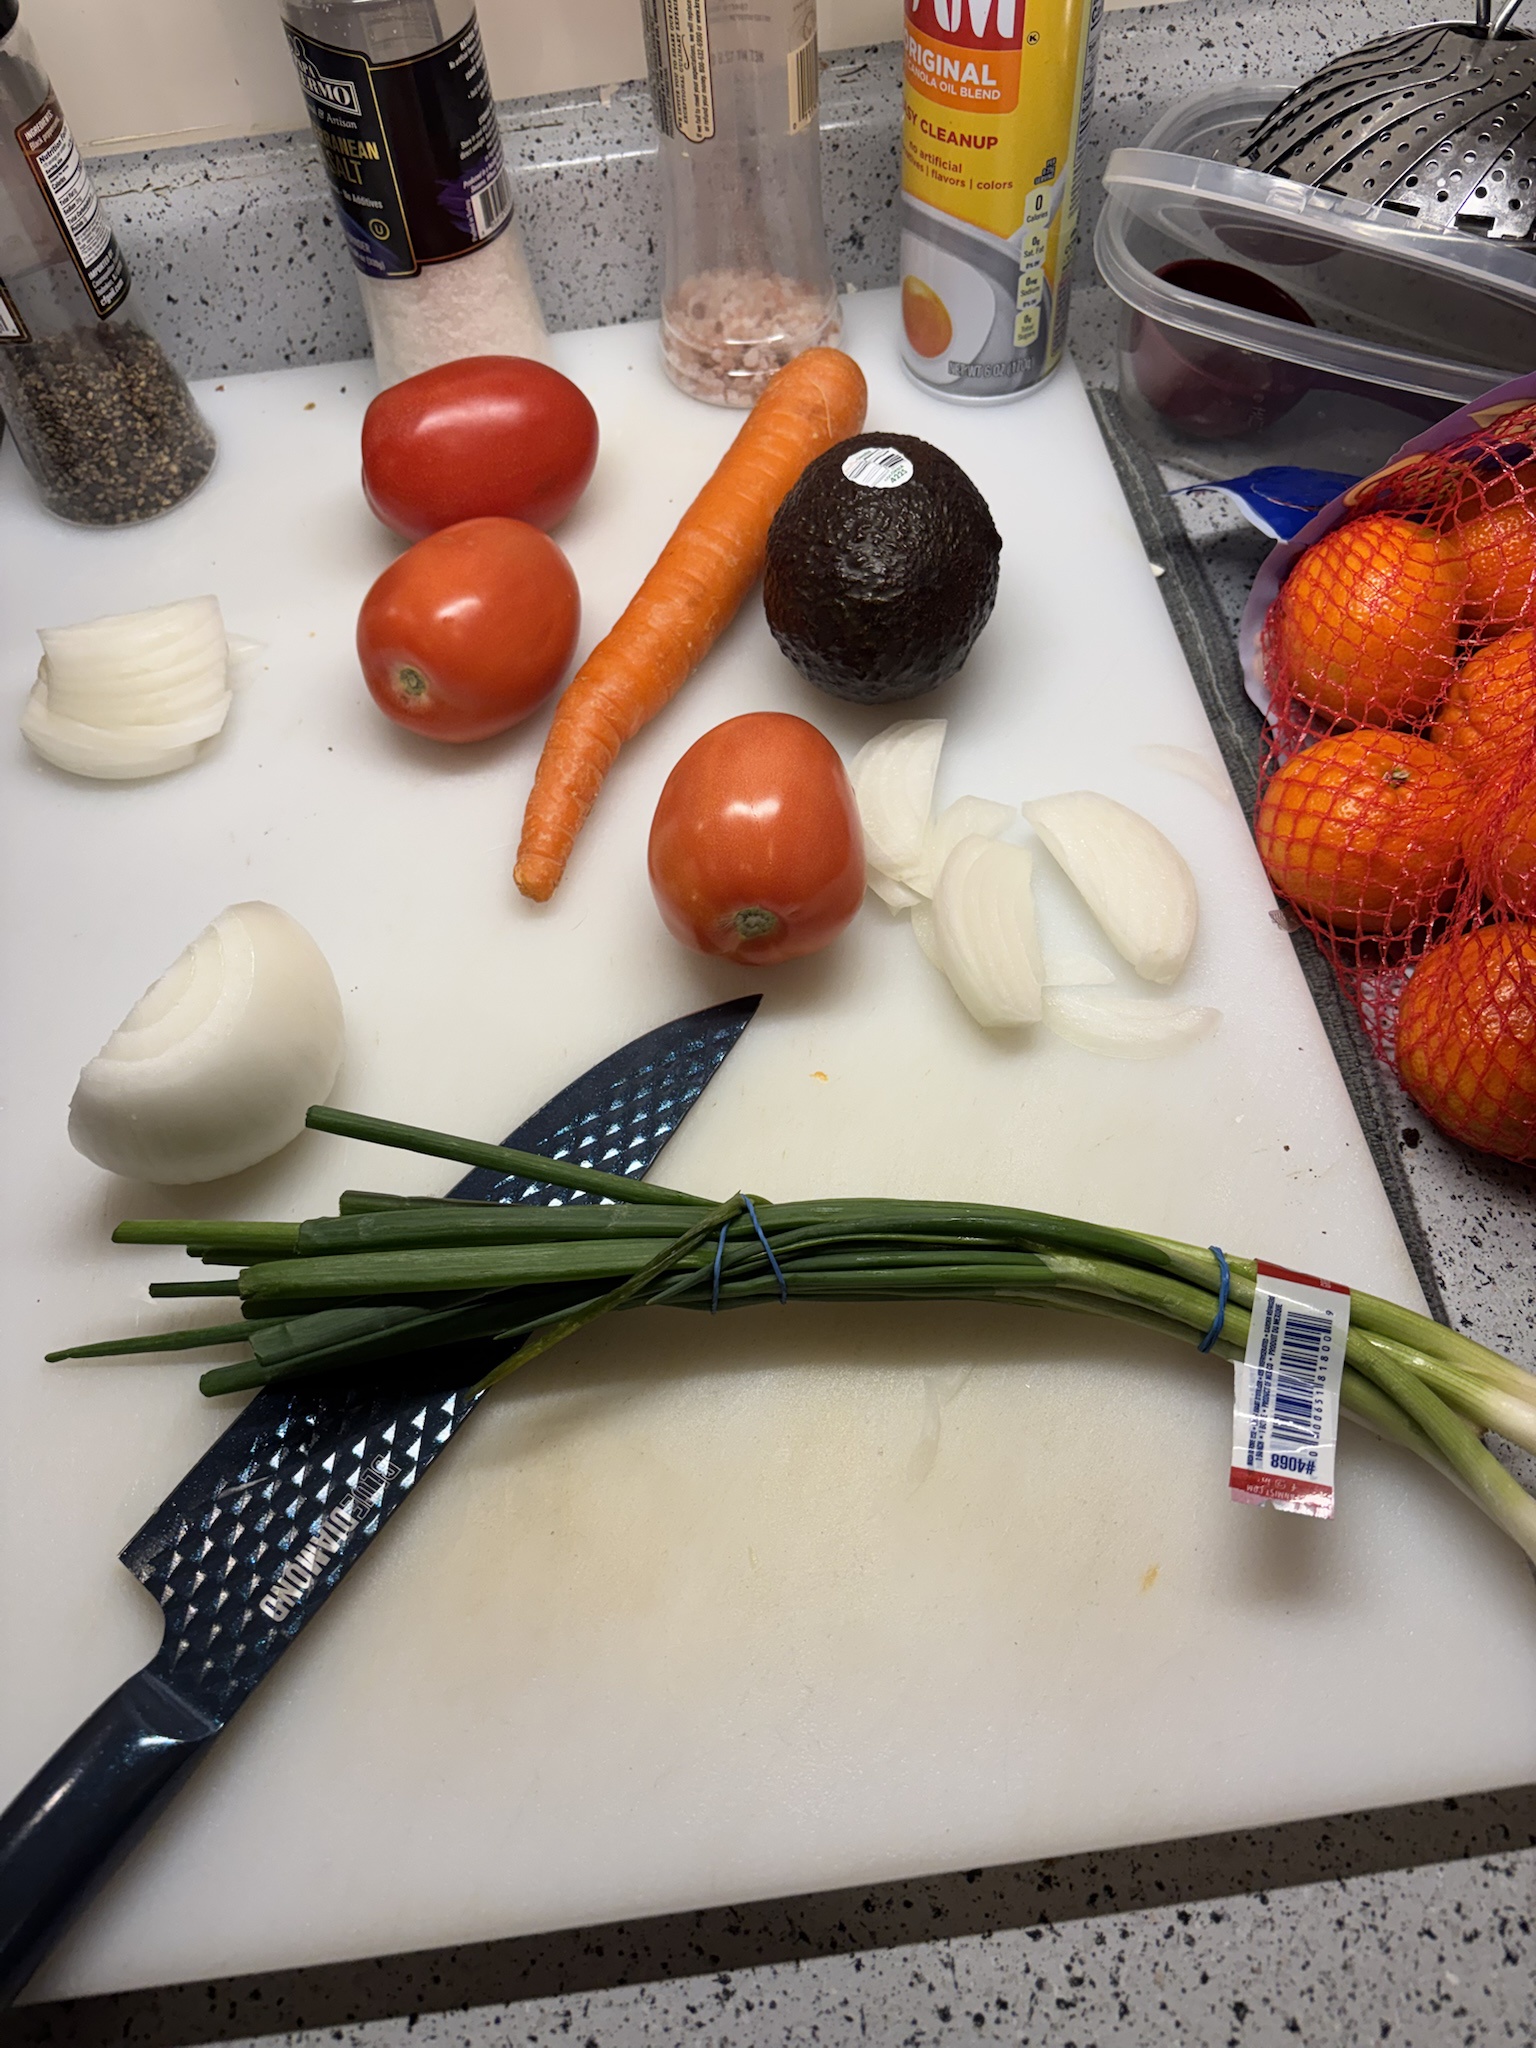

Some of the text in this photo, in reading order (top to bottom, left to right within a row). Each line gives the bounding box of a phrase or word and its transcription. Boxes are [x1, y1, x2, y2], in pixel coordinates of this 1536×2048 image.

[676, 33, 684, 73] CULINARY
[673, 59, 677, 70] TO
[907, 60, 1001, 100] CANOLA OIL BLEND
[680, 75, 688, 124] EXCEPTIONAL
[326, 113, 358, 129] Artisan
[678, 117, 683, 128] WE
[920, 119, 999, 150] CLEANUP
[28, 135, 43, 151] Black
[38, 139, 61, 164] Nutrition
[324, 151, 363, 185] SALT
[920, 150, 963, 174] artificial
[52, 176, 67, 190] Calories
[931, 169, 966, 188] flavors
[976, 180, 1013, 190] colors
[59, 196, 69, 206] Total
[63, 202, 76, 215] Sodium
[352, 193, 384, 209] Additives
[1035, 194, 1043, 211] 0
[67, 214, 77, 224] Total
[1026, 211, 1048, 223] Calories
[1032, 236, 1040, 246] 0g
[1035, 246, 1045, 254] Fat
[1020, 286, 1041, 297] Sodium
[966, 364, 981, 378] WT
[983, 365, 992, 378] 6
[992, 363, 1005, 378] OZ
[890, 469, 908, 483] 4225
[1273, 1303, 1283, 1325] MEXIQUE
[1271, 1325, 1279, 1334] DU
[1268, 1334, 1278, 1356] PRODUIT
[1317, 1335, 1332, 1382] 81800
[1262, 1387, 1271, 1408] PRODUCT
[1312, 1390, 1324, 1430] 00651
[1259, 1414, 1268, 1430] BOTE
[1270, 1453, 1316, 1475] #4068
[258, 1454, 402, 1623] BLUE DIAMOND
